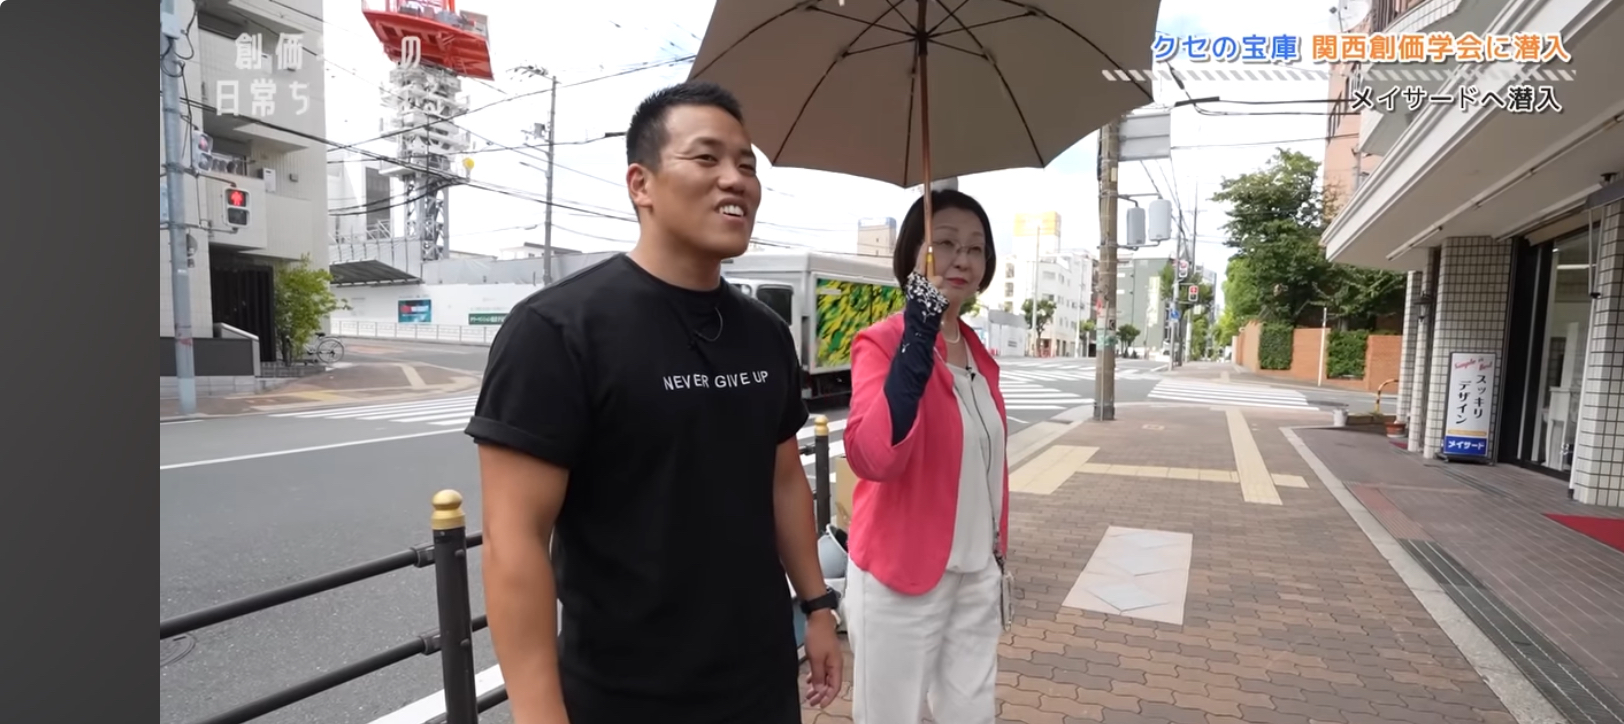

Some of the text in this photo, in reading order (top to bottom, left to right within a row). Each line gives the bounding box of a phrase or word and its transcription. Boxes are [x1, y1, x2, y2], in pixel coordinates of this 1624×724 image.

[663, 370, 769, 391] NEVER GIVE UP
[1473, 374, 1487, 419] スッキリ
[1455, 380, 1472, 425] デザイン
[1448, 439, 1485, 451] メイサード
